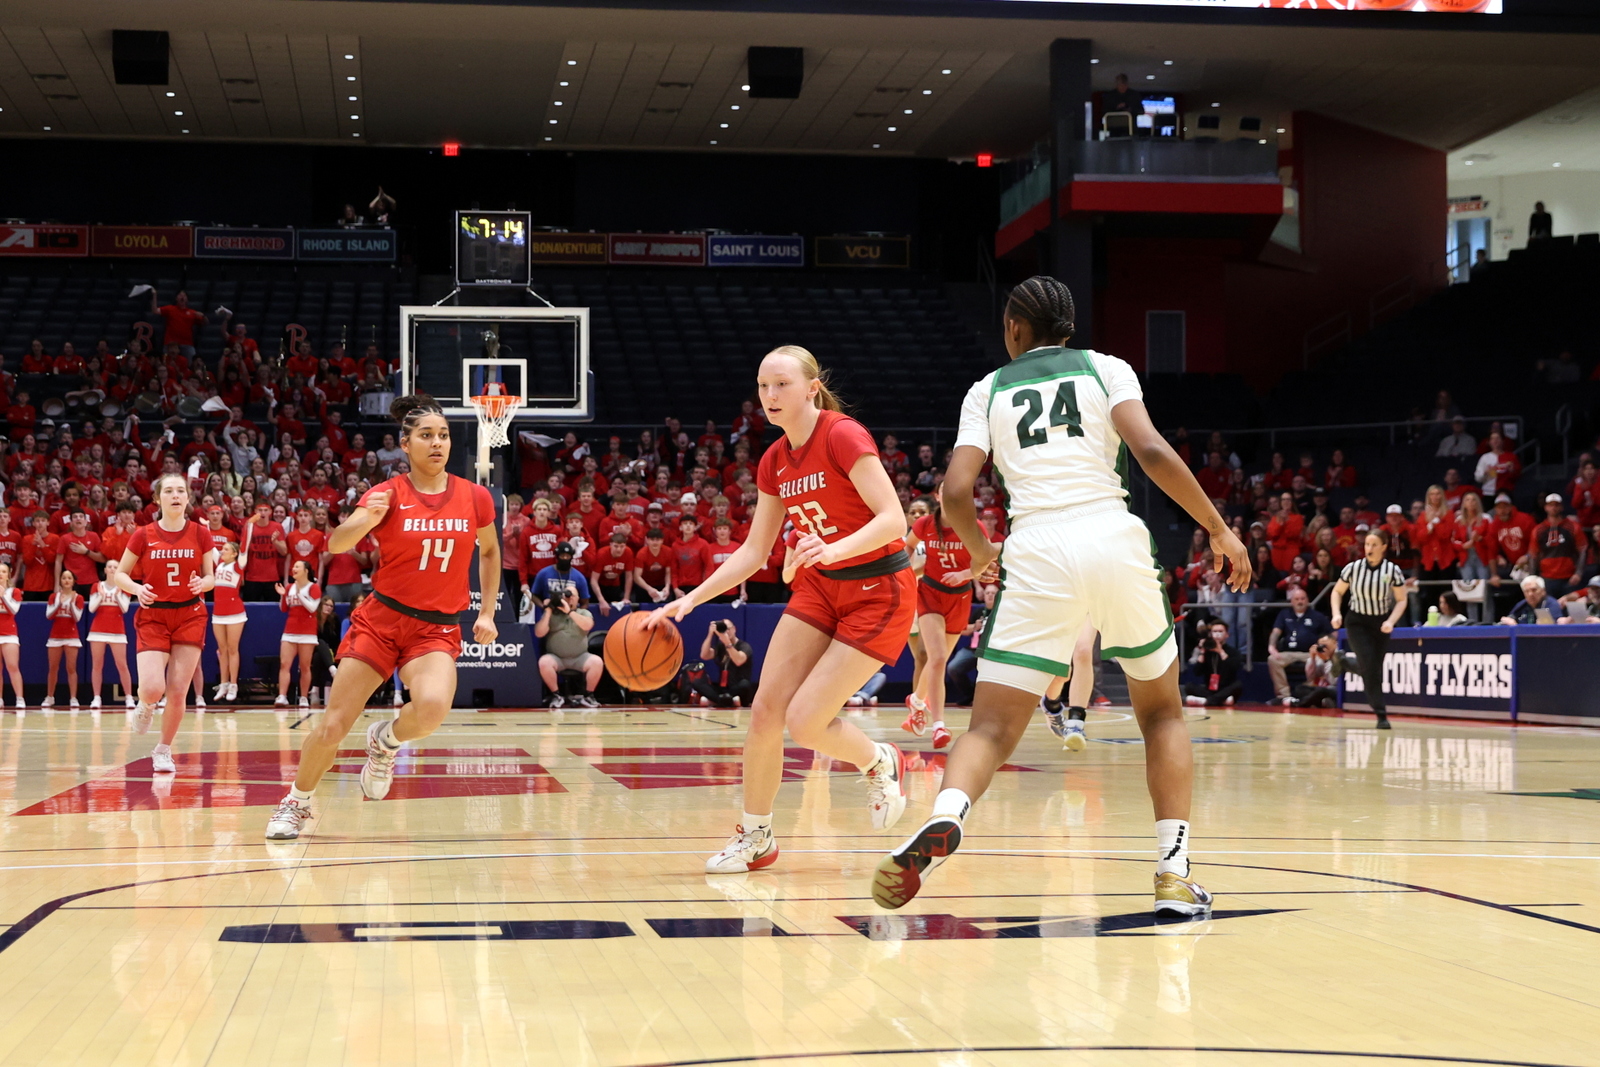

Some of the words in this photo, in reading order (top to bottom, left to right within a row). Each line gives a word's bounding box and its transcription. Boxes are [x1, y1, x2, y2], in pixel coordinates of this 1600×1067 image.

[478, 218, 523, 239] 7:14
[114, 235, 168, 249] LOYOLA
[204, 236, 286, 250] RICHMOND
[303, 239, 342, 251] RHODE
[347, 239, 390, 251] ISLAND
[533, 242, 604, 255] BONAVENTURE
[712, 245, 754, 257] SAINT
[759, 245, 800, 258] LOUIS
[845, 245, 882, 258] VCU
[1012, 381, 1085, 449] 24
[403, 518, 469, 532] BELLEVUE
[787, 500, 838, 537] 32
[150, 549, 195, 560] BELLEVUE
[418, 538, 455, 573] 14
[937, 552, 958, 569] 21
[166, 562, 180, 587] 2
[492, 661, 516, 669] dayton
[1424, 653, 1513, 698] FLYERS
